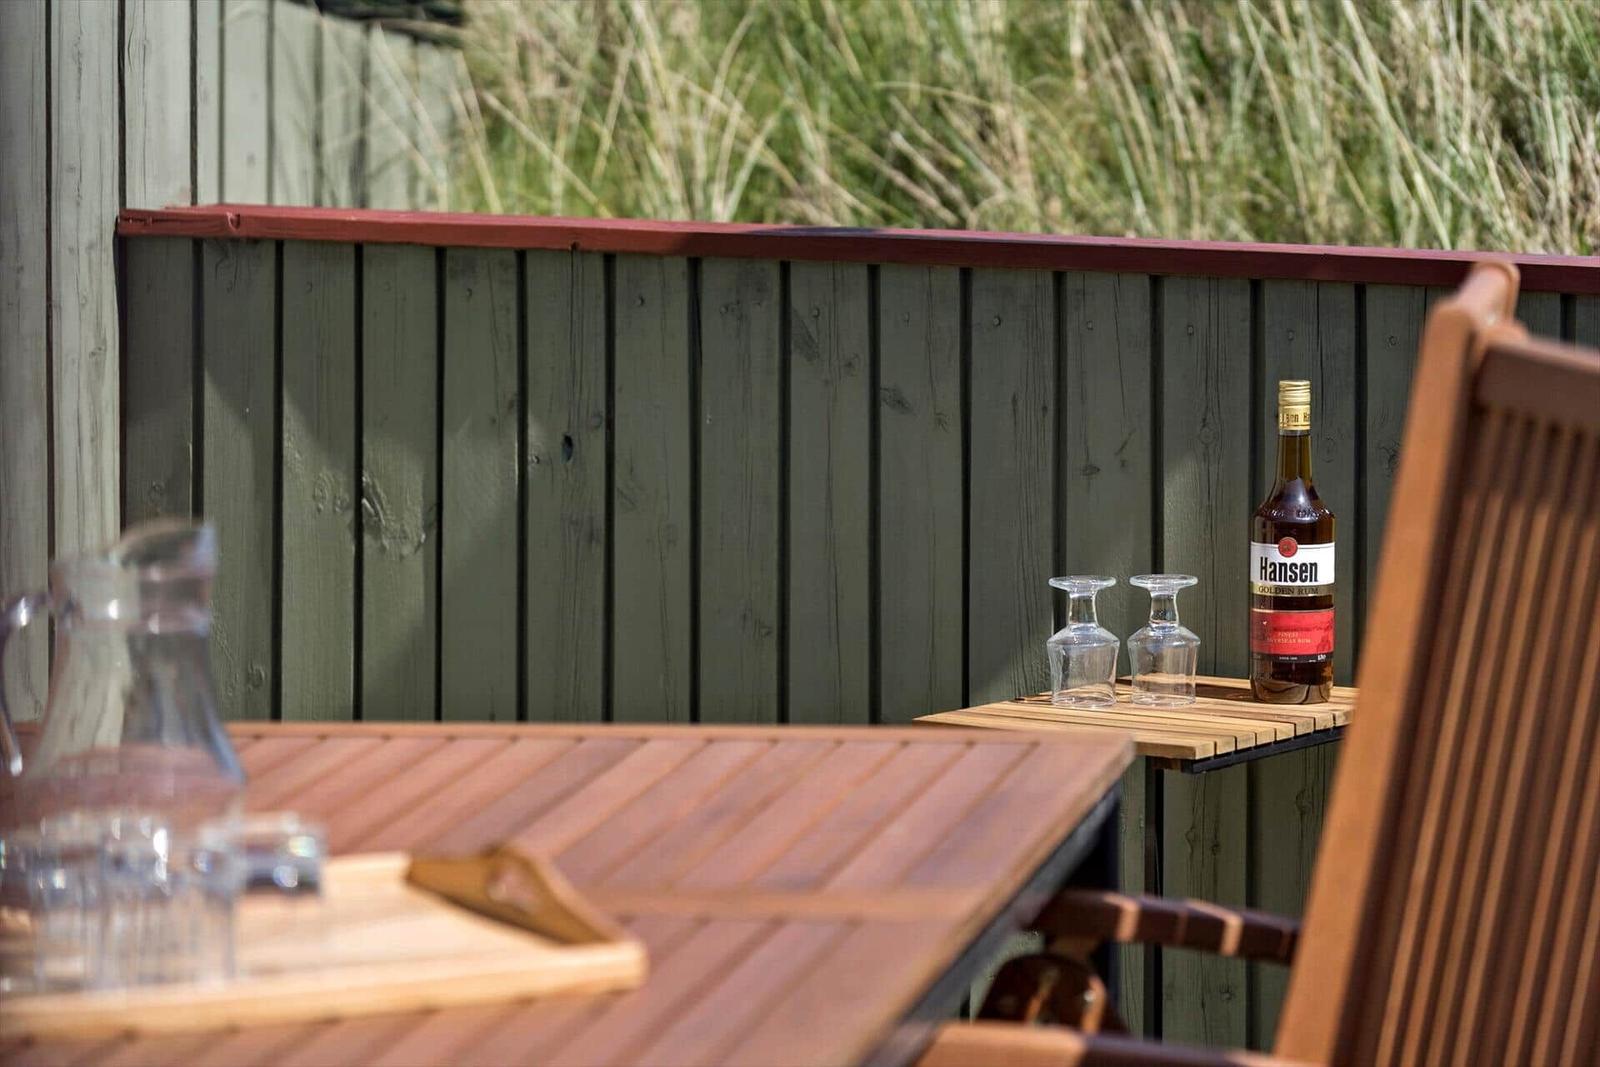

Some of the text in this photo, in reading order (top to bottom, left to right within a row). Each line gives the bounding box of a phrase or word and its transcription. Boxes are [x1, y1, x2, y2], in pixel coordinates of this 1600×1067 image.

[1260, 556, 1318, 583] Hansen
[1258, 586, 1319, 595] GOLDEN RUM
